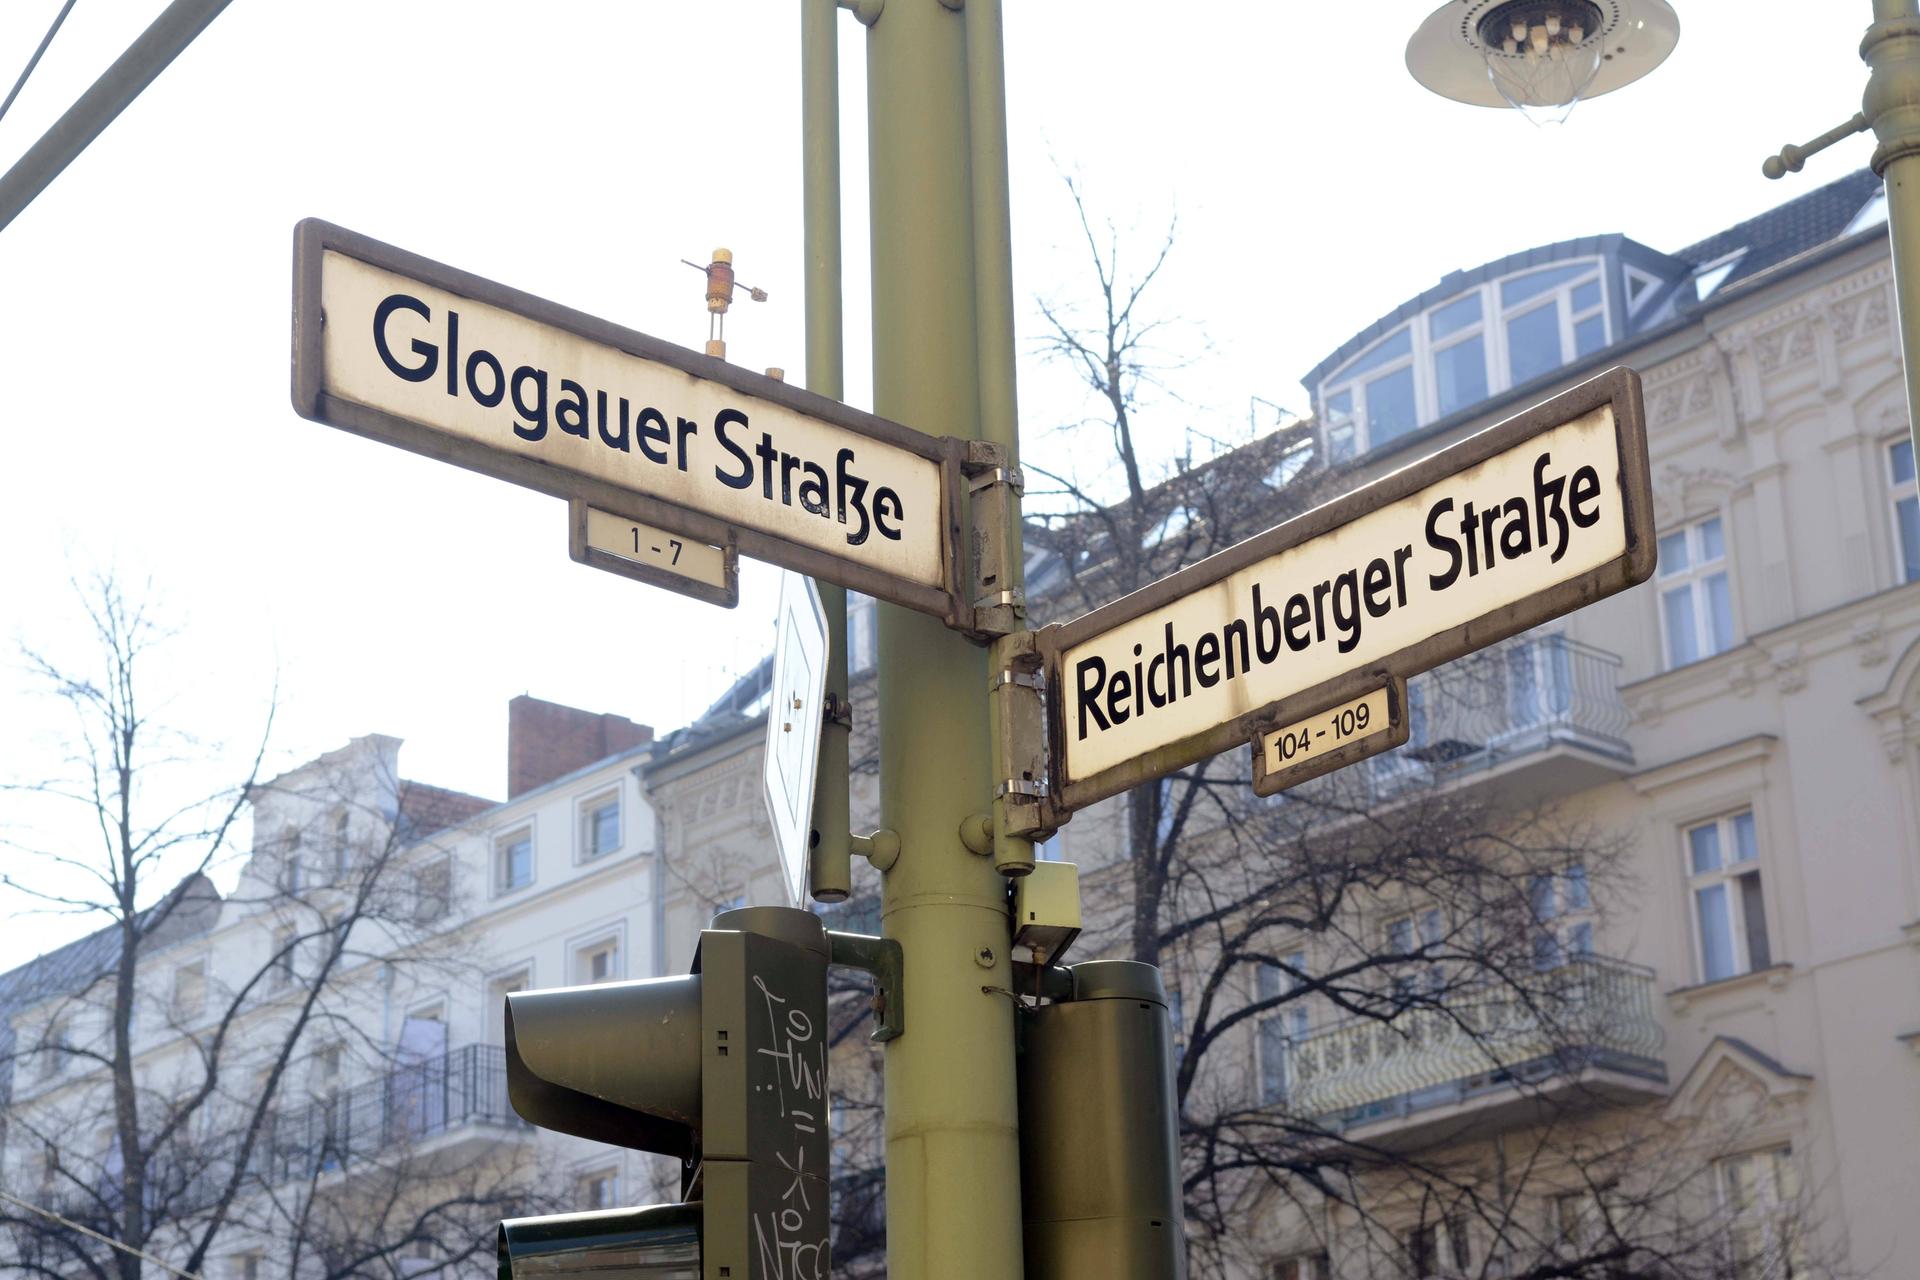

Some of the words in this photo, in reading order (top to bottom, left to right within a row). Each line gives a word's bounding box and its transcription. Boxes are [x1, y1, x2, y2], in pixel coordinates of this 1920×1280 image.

[372, 294, 698, 473] Glogauer
[714, 408, 905, 546] Straße
[1075, 544, 1413, 741] Reichenberger
[1425, 452, 1601, 593] Straße
